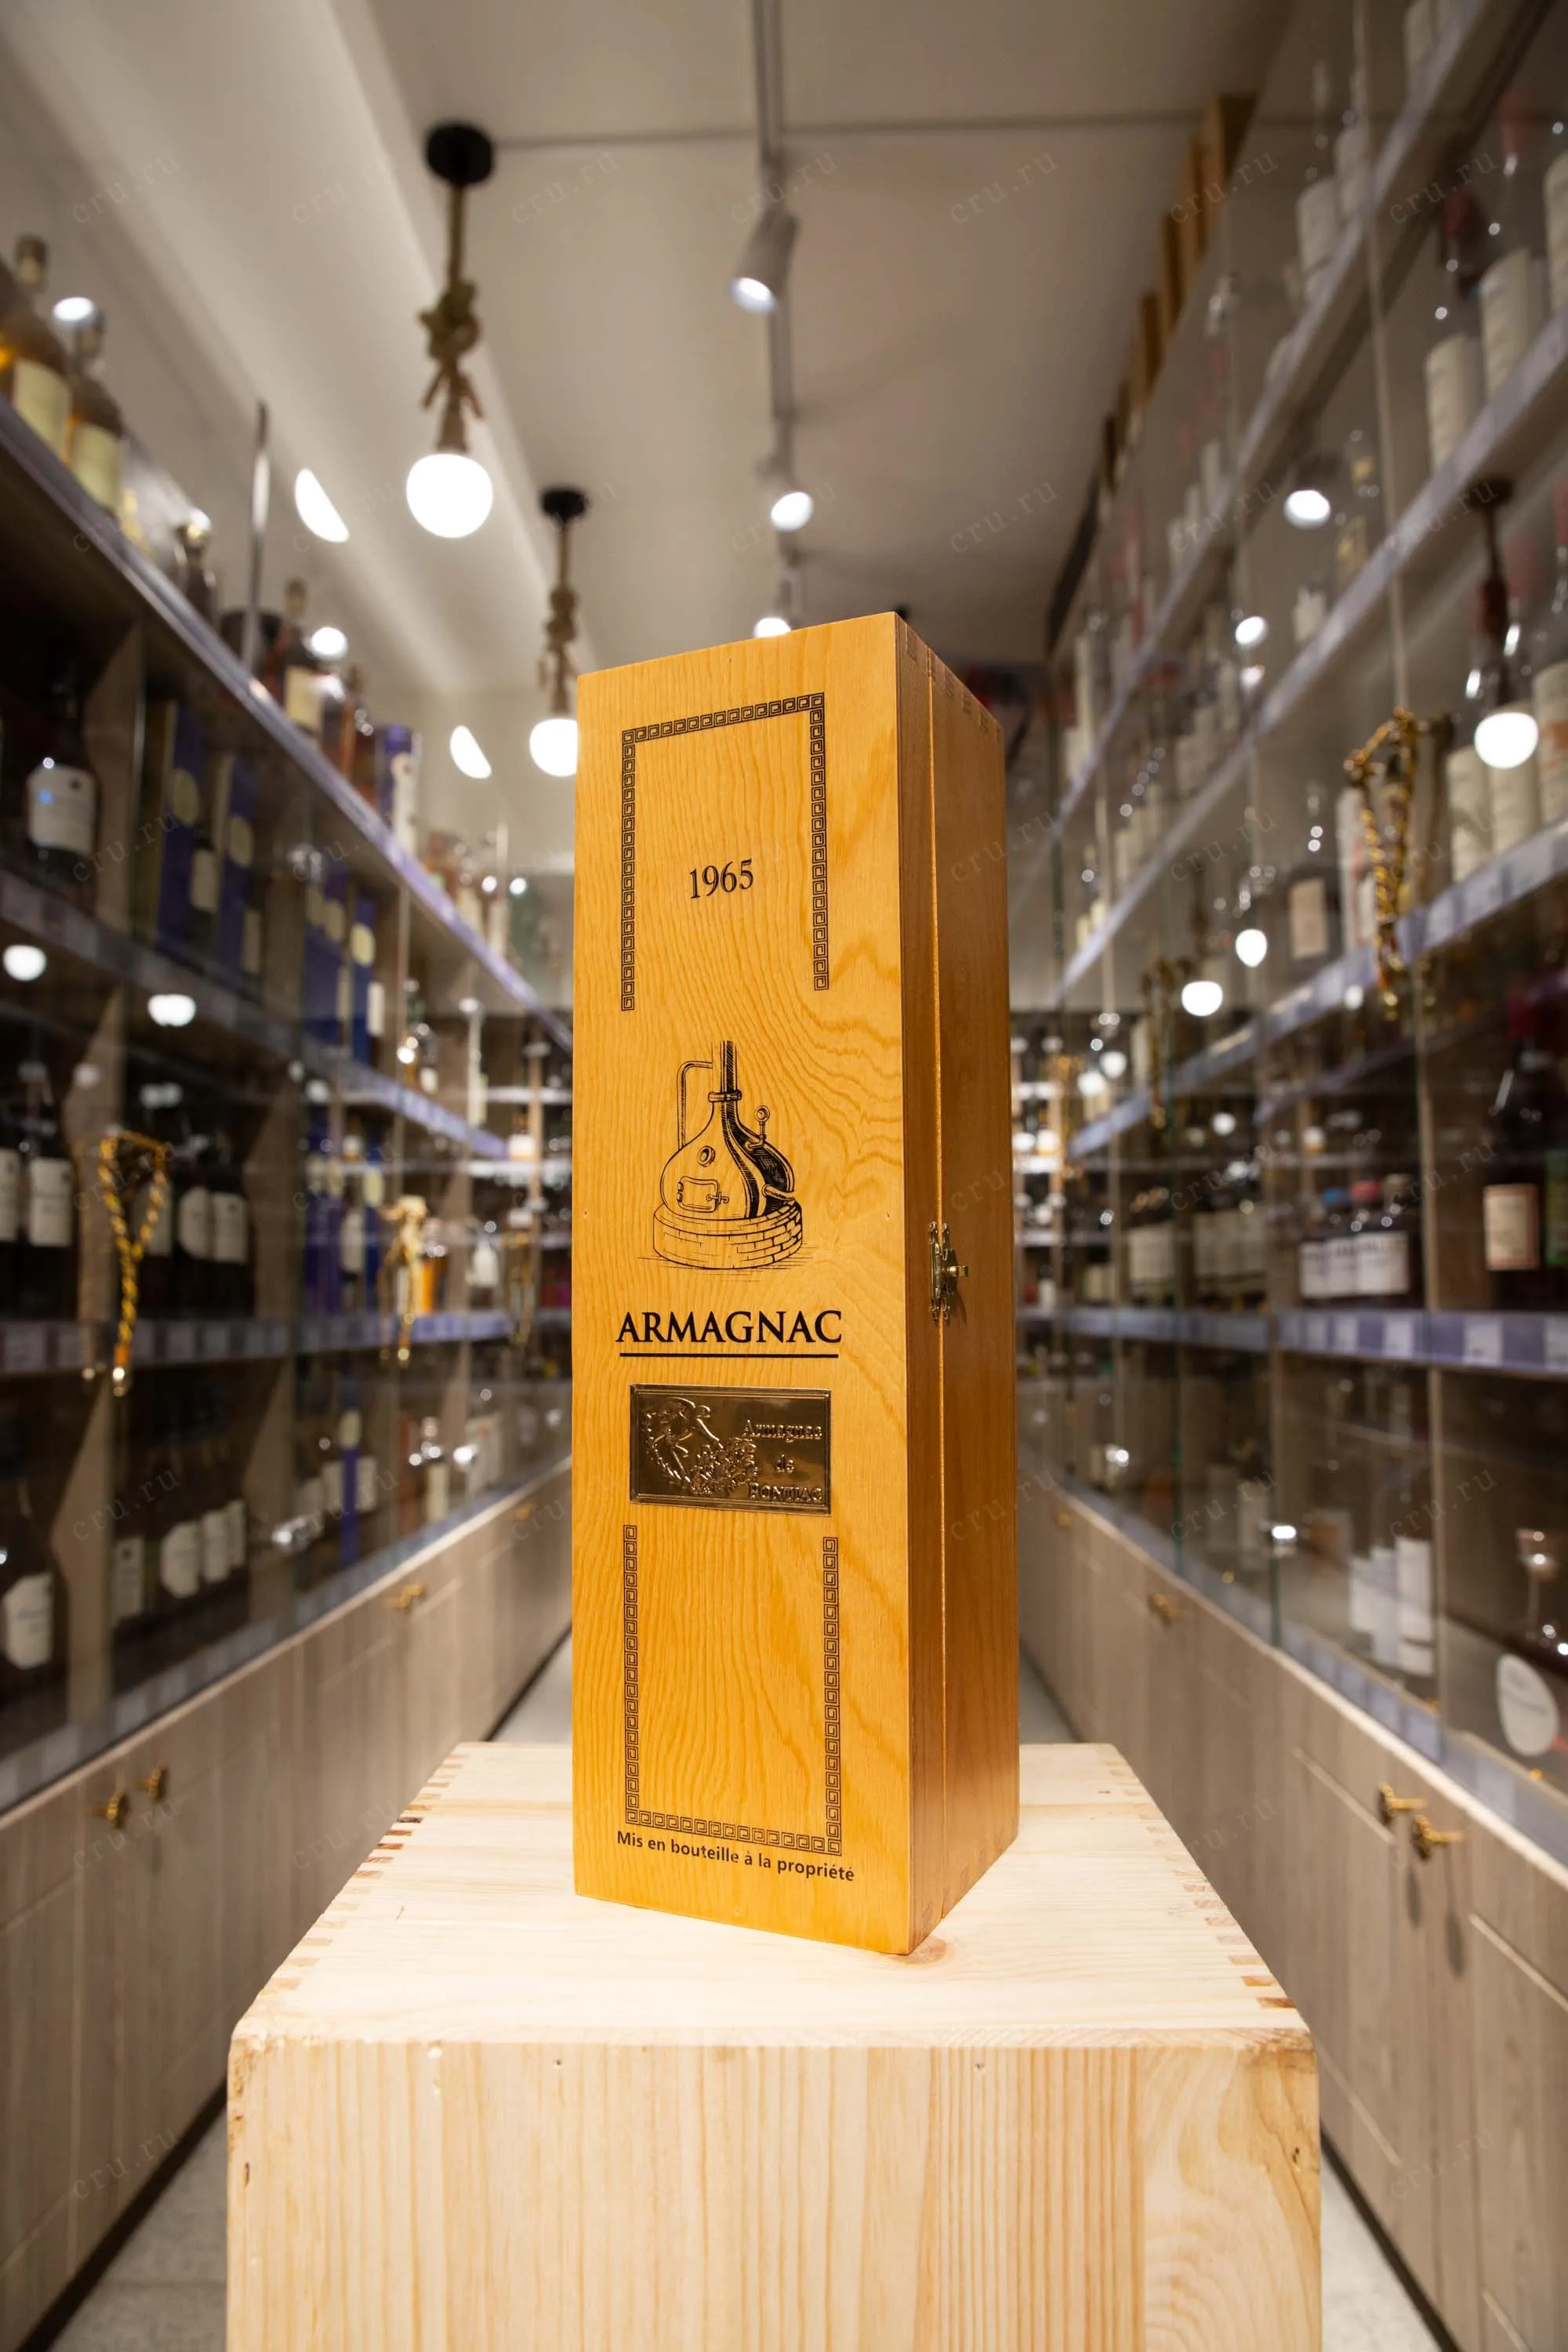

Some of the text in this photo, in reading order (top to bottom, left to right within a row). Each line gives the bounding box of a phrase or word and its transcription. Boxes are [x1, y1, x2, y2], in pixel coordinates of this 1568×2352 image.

[690, 858, 753, 899] 1965
[615, 1310, 842, 1343] ARMAGNAC
[616, 1831, 855, 1882] Mis en bouteille à la propriété
